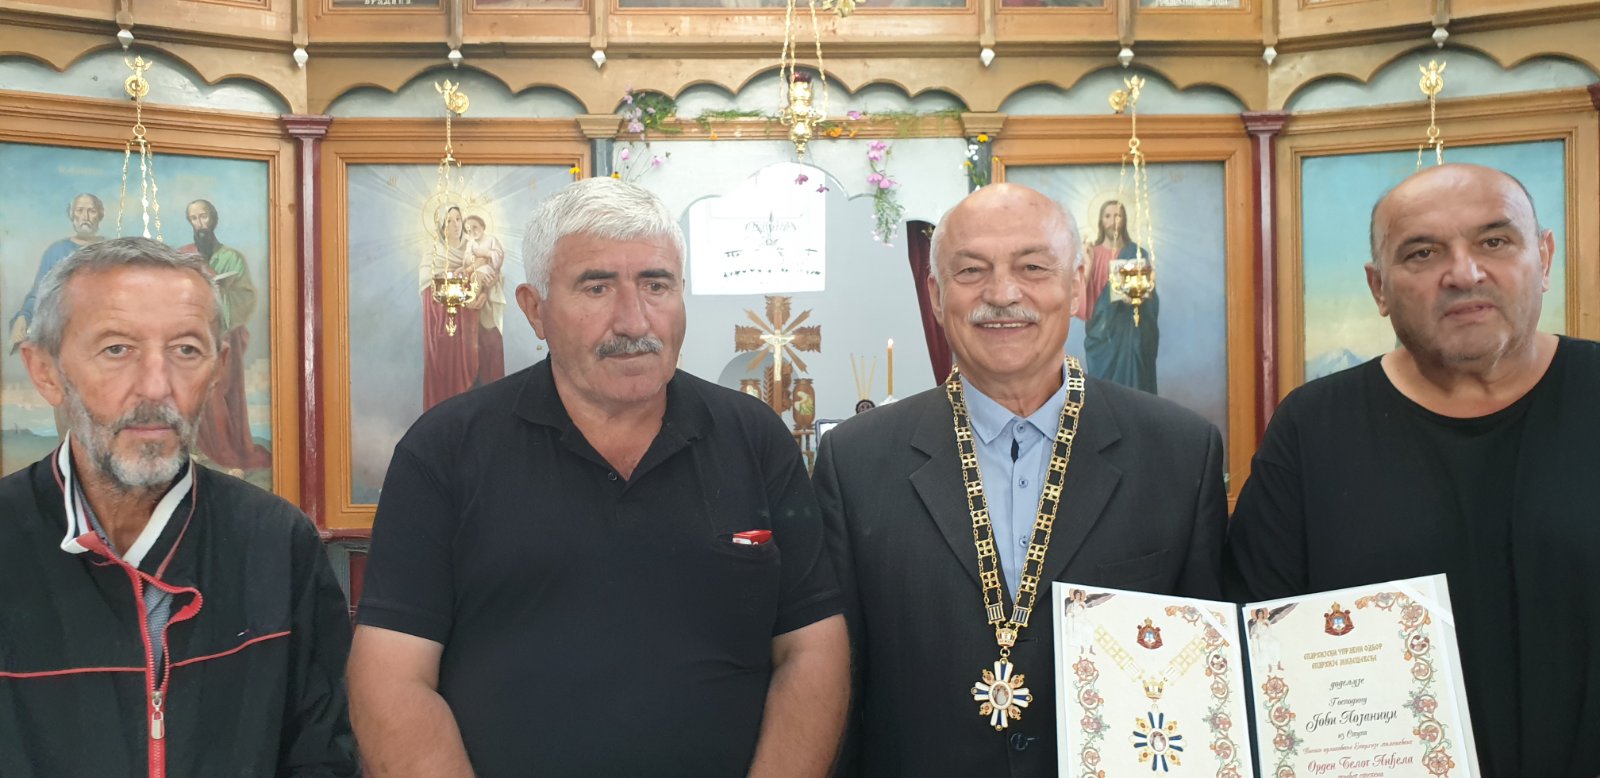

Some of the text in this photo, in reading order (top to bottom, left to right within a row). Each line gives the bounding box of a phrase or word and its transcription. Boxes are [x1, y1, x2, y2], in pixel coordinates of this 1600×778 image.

[1306, 711, 1336, 733] Јови
[1308, 760, 1335, 775] Орден
[1372, 752, 1413, 769] Анђела
